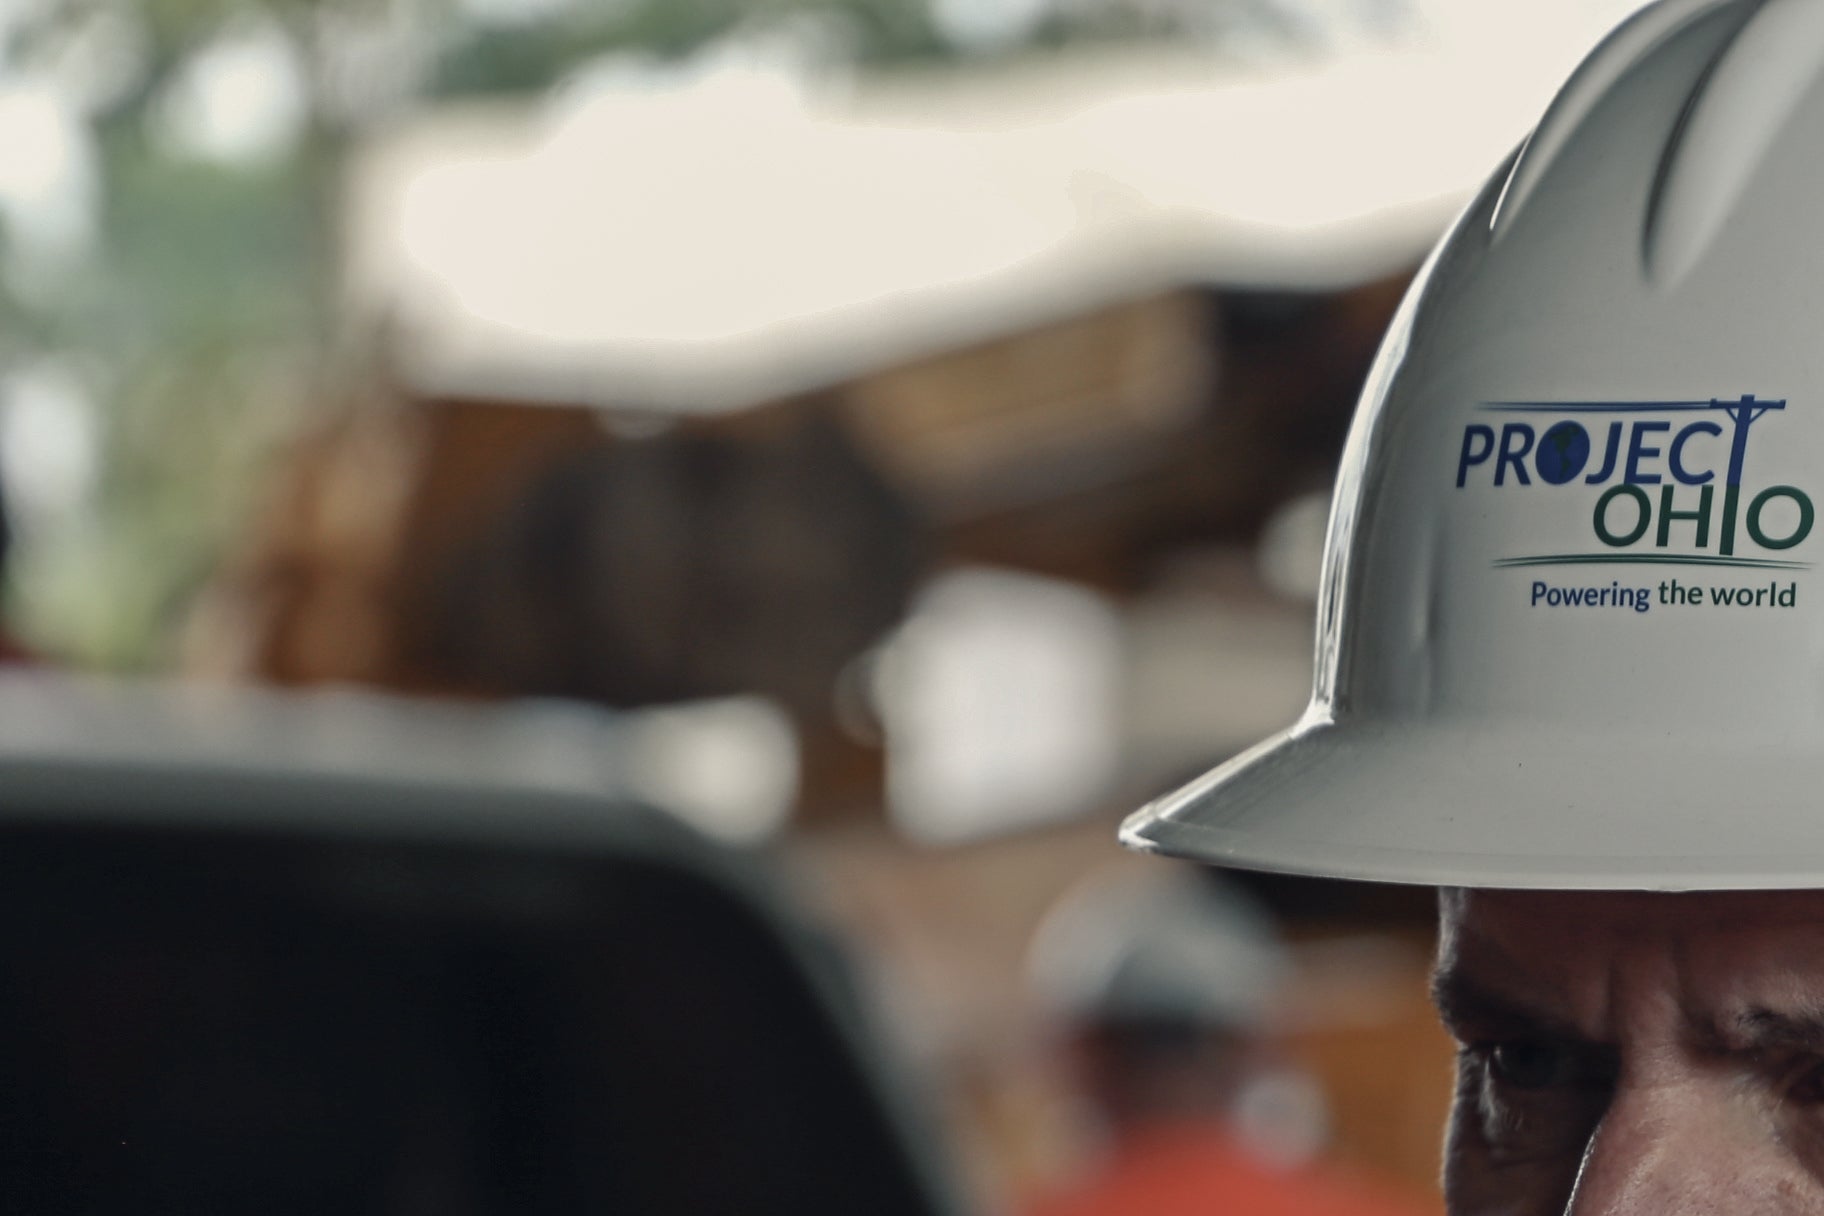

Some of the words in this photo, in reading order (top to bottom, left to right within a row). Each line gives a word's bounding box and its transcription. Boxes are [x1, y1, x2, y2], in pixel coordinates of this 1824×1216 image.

[1456, 395, 1787, 488] PROJECT
[1593, 483, 1815, 556] OHIO
[1530, 580, 1651, 612] Powering
[1658, 579, 1703, 605] the
[1710, 582, 1797, 607] world
